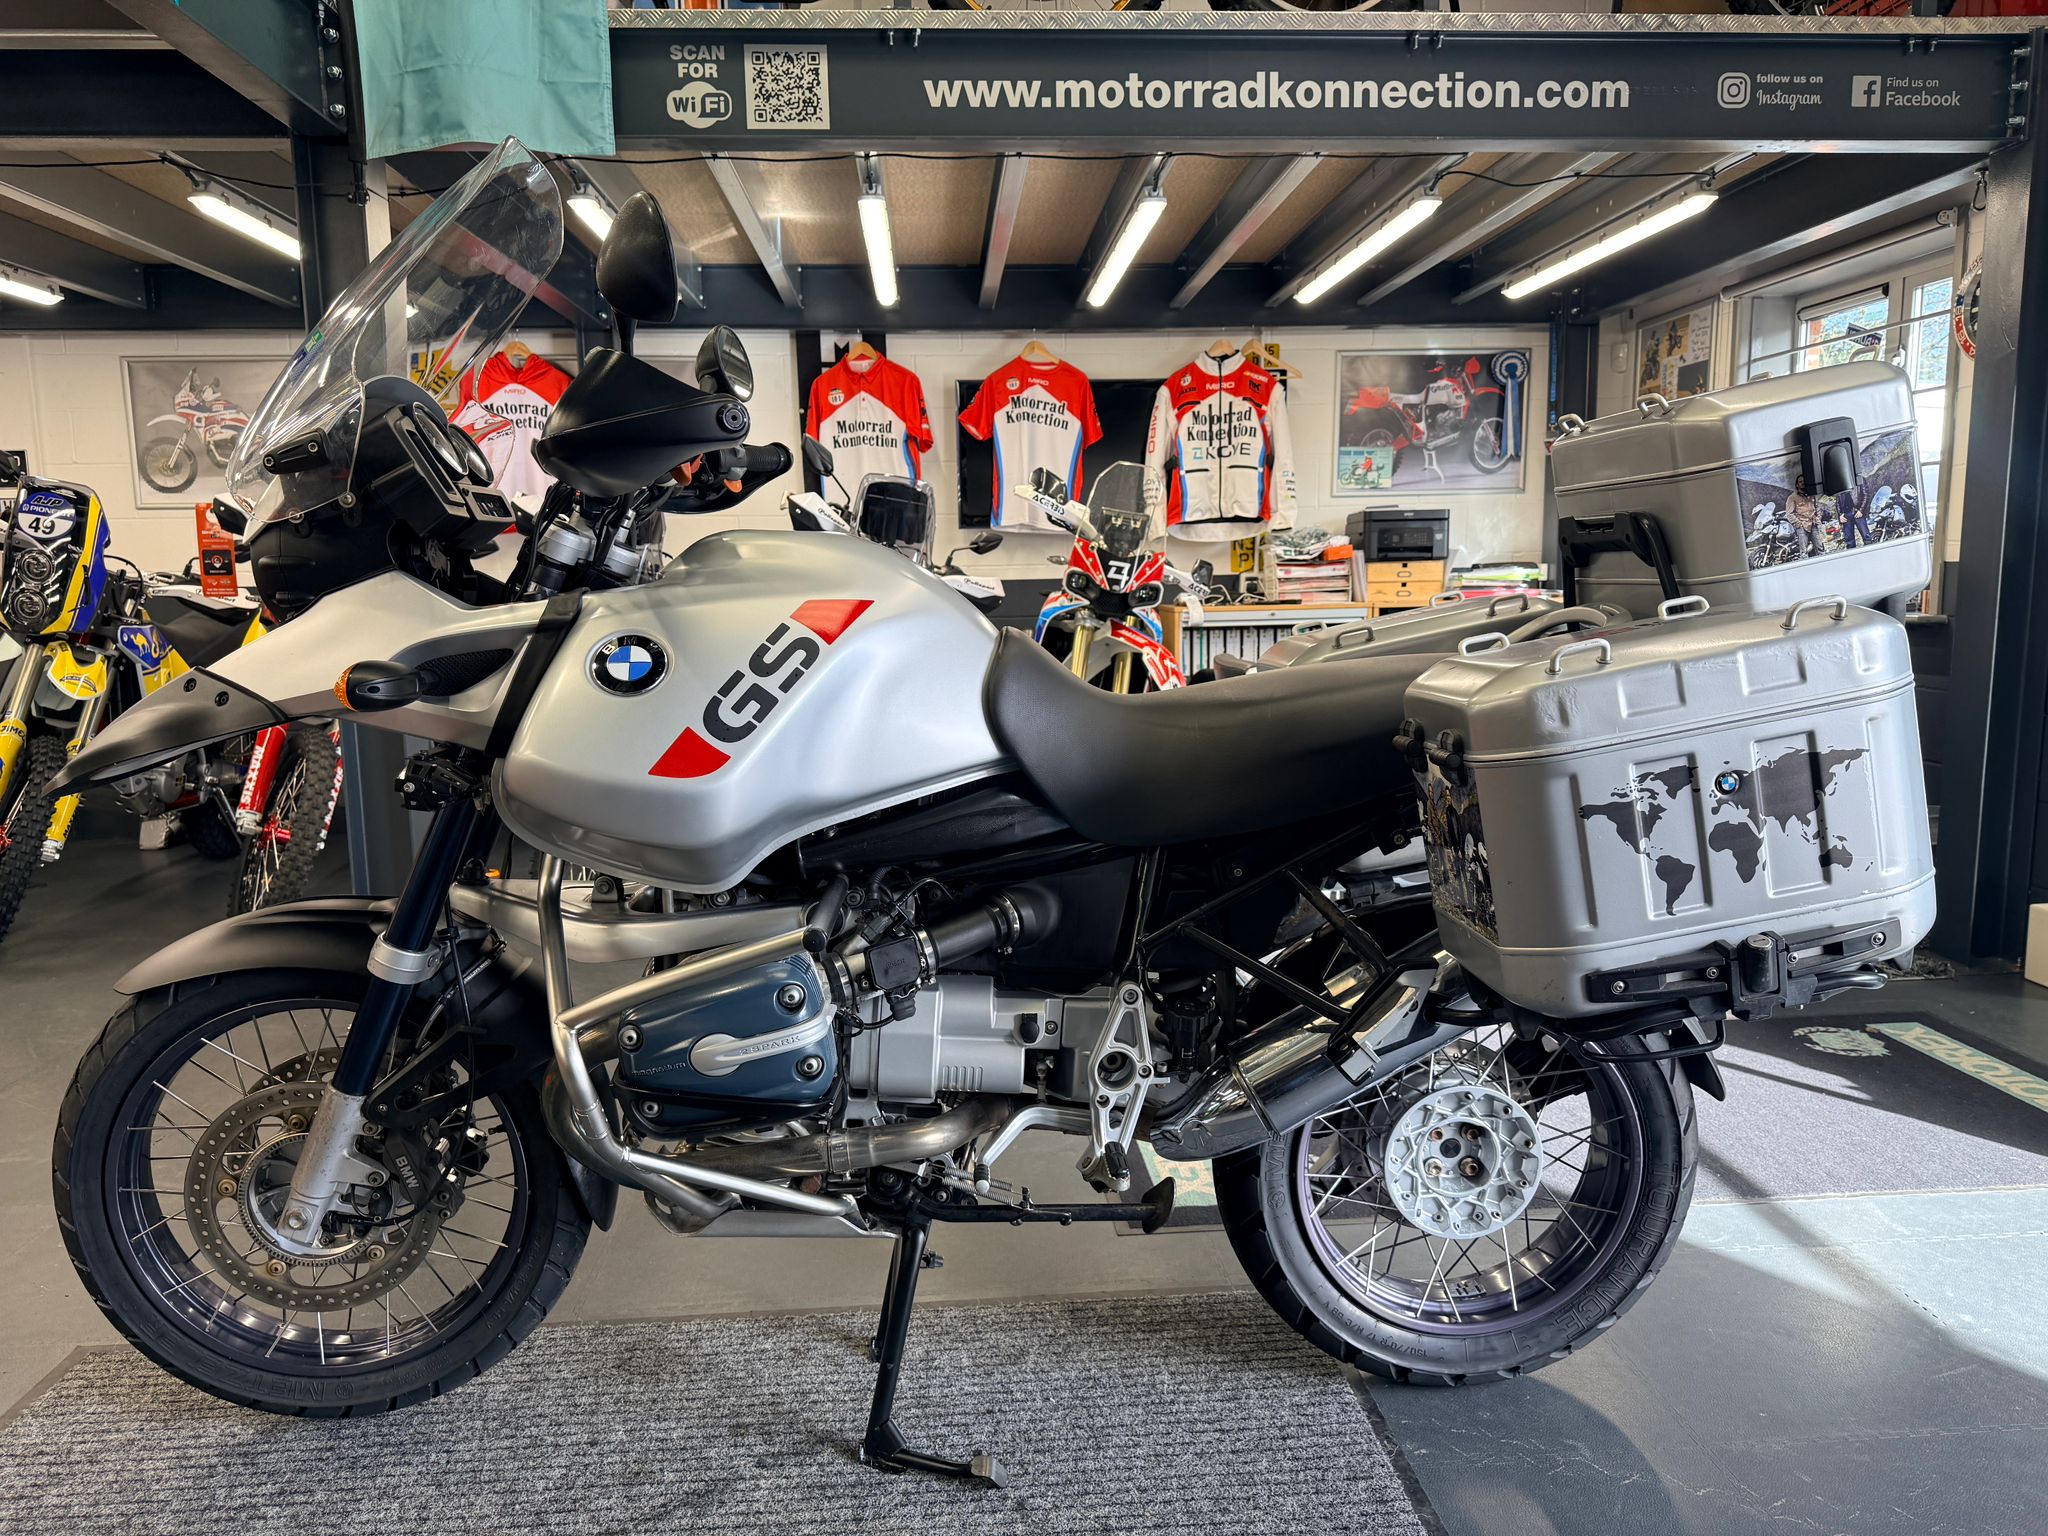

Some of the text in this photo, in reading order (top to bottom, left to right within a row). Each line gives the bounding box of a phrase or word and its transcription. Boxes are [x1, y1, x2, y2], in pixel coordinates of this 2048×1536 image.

[670, 45, 725, 60] SCAN
[677, 63, 718, 78] FOR
[1756, 74, 1823, 83] follow us on
[923, 71, 1630, 109] www.motorradkonnection.com
[1887, 77, 1939, 87] Find us on
[1756, 89, 1822, 111] Instagram
[1885, 91, 1961, 106] Facebook
[1005, 410, 1069, 430] Konection
[1191, 406, 1252, 426] Moorrad
[836, 420, 893, 435] Motorrad
[832, 434, 898, 449] Konnection
[1205, 442, 1252, 460] KOVE
[31, 495, 64, 506] AJP
[30, 504, 75, 517] PIONE
[28, 517, 56, 535] 49
[702, 622, 821, 743] GS
[241, 744, 264, 806] MAXXIS
[1880, 1026, 2048, 1108] OTOREX
[395, 1155, 420, 1188] BMW
[1552, 1163, 1680, 1341] TOURANCE
